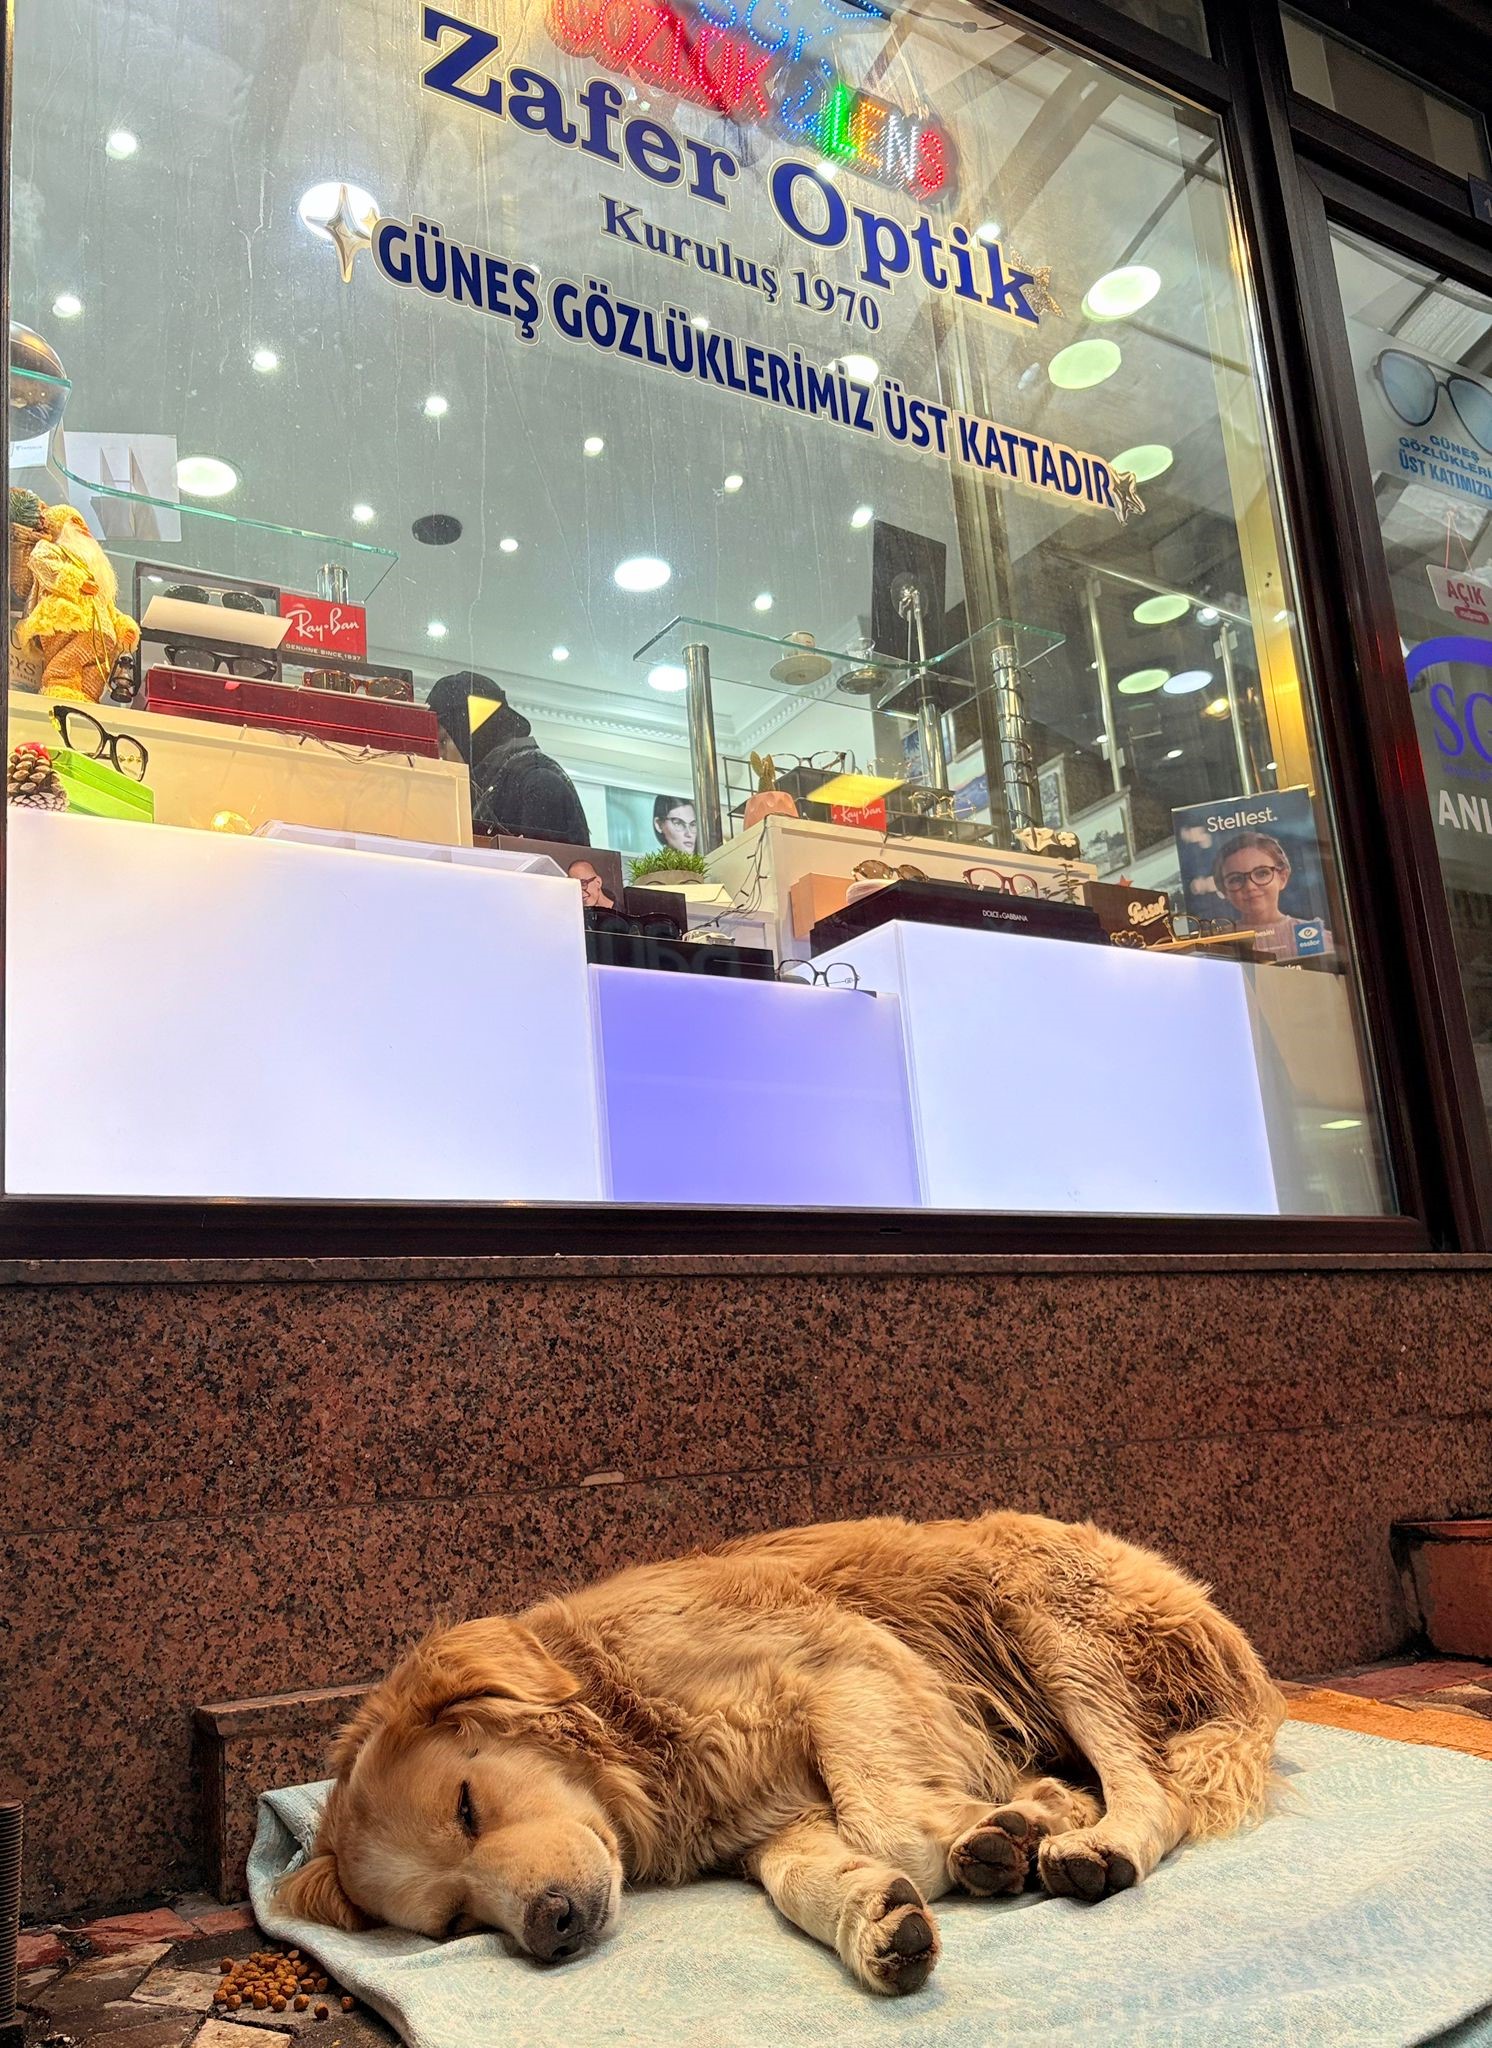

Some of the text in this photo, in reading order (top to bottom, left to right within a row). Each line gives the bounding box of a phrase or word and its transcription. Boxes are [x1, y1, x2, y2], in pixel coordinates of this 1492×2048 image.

[423, 6, 1040, 324] Zafer Optik
[831, 86, 945, 190] LENS
[602, 195, 880, 331] Kuruluş 1970
[378, 221, 1116, 508] GÜNEŞ GÖZLÜKLERİMİZ ÜST KATTADIR
[1399, 448, 1426, 476] ÜST
[1430, 434, 1480, 463] GÜNEŞ
[1447, 579, 1487, 608] AÇIK
[285, 643, 318, 654] GENUINE
